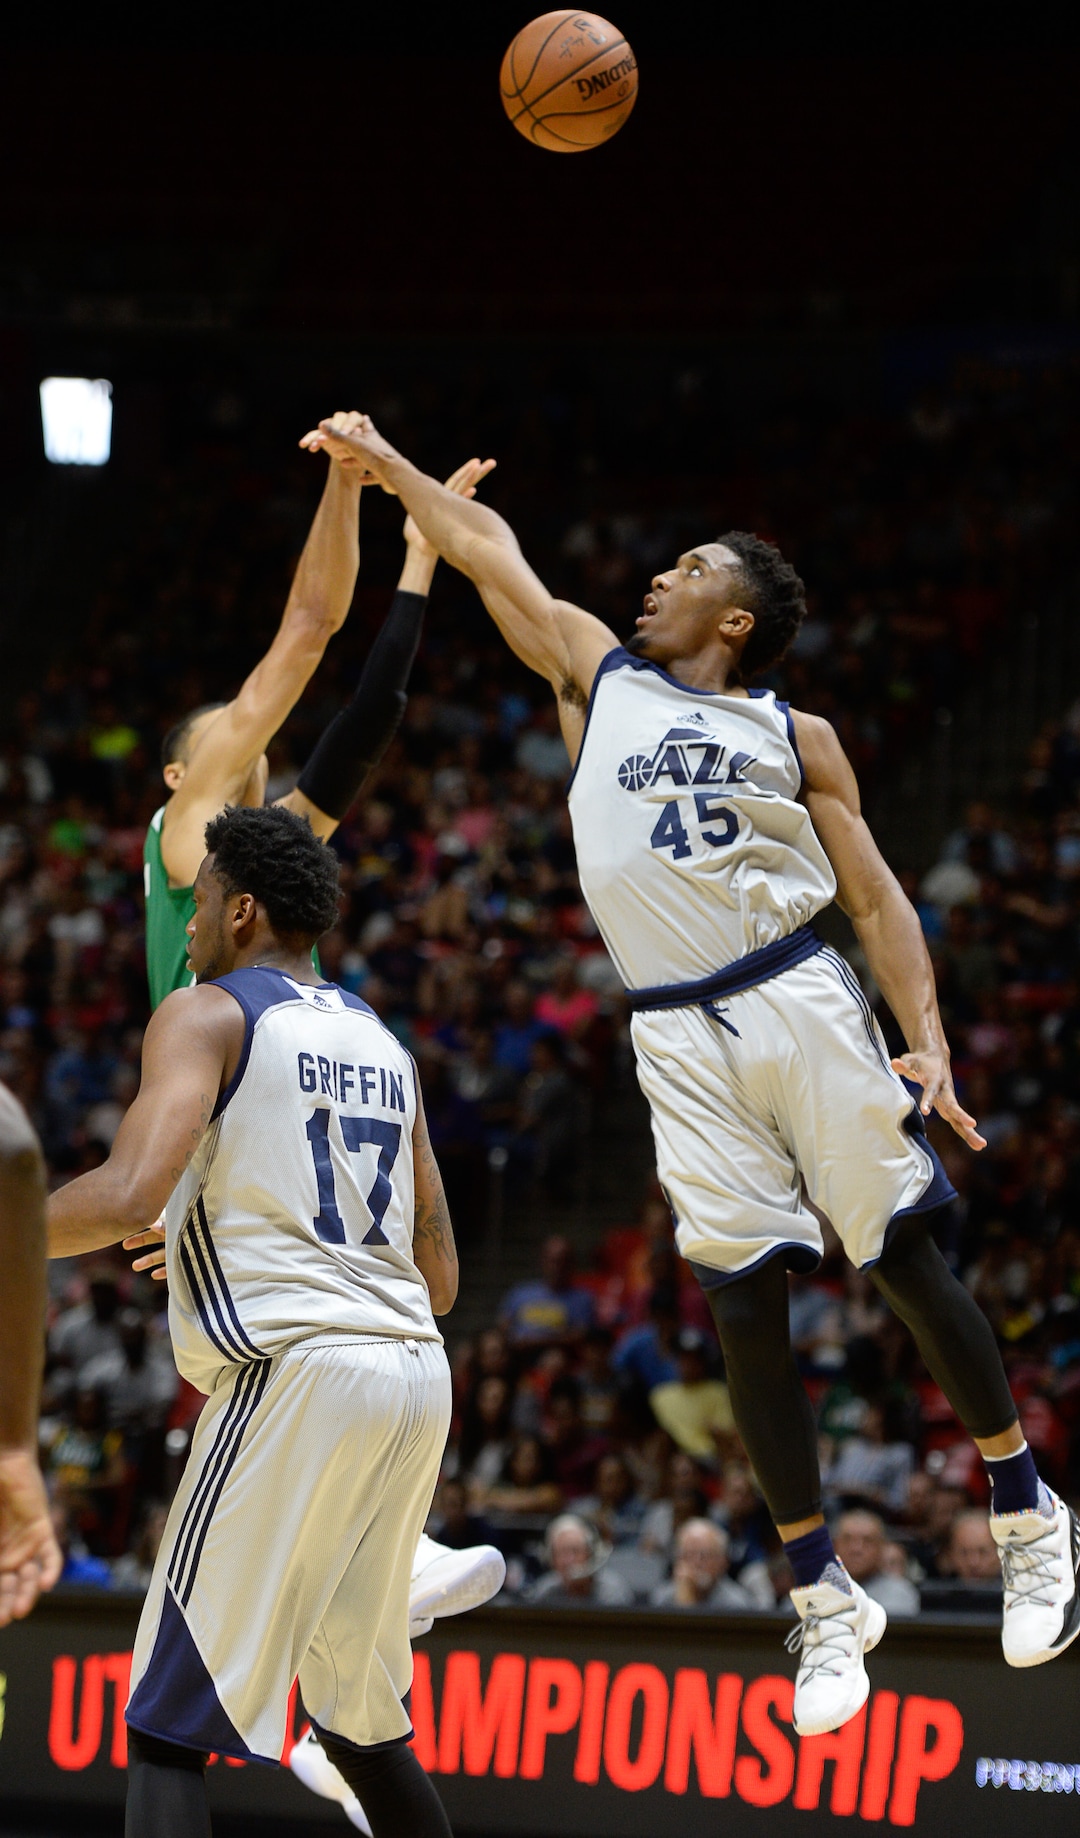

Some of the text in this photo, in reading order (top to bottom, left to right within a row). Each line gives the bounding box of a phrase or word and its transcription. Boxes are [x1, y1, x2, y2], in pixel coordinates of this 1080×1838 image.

[650, 792, 741, 861] 45
[297, 1052, 406, 1113] GRIFFIN
[305, 1107, 402, 1246] 17
[280, 1650, 964, 1827] AMPIONSHIP
